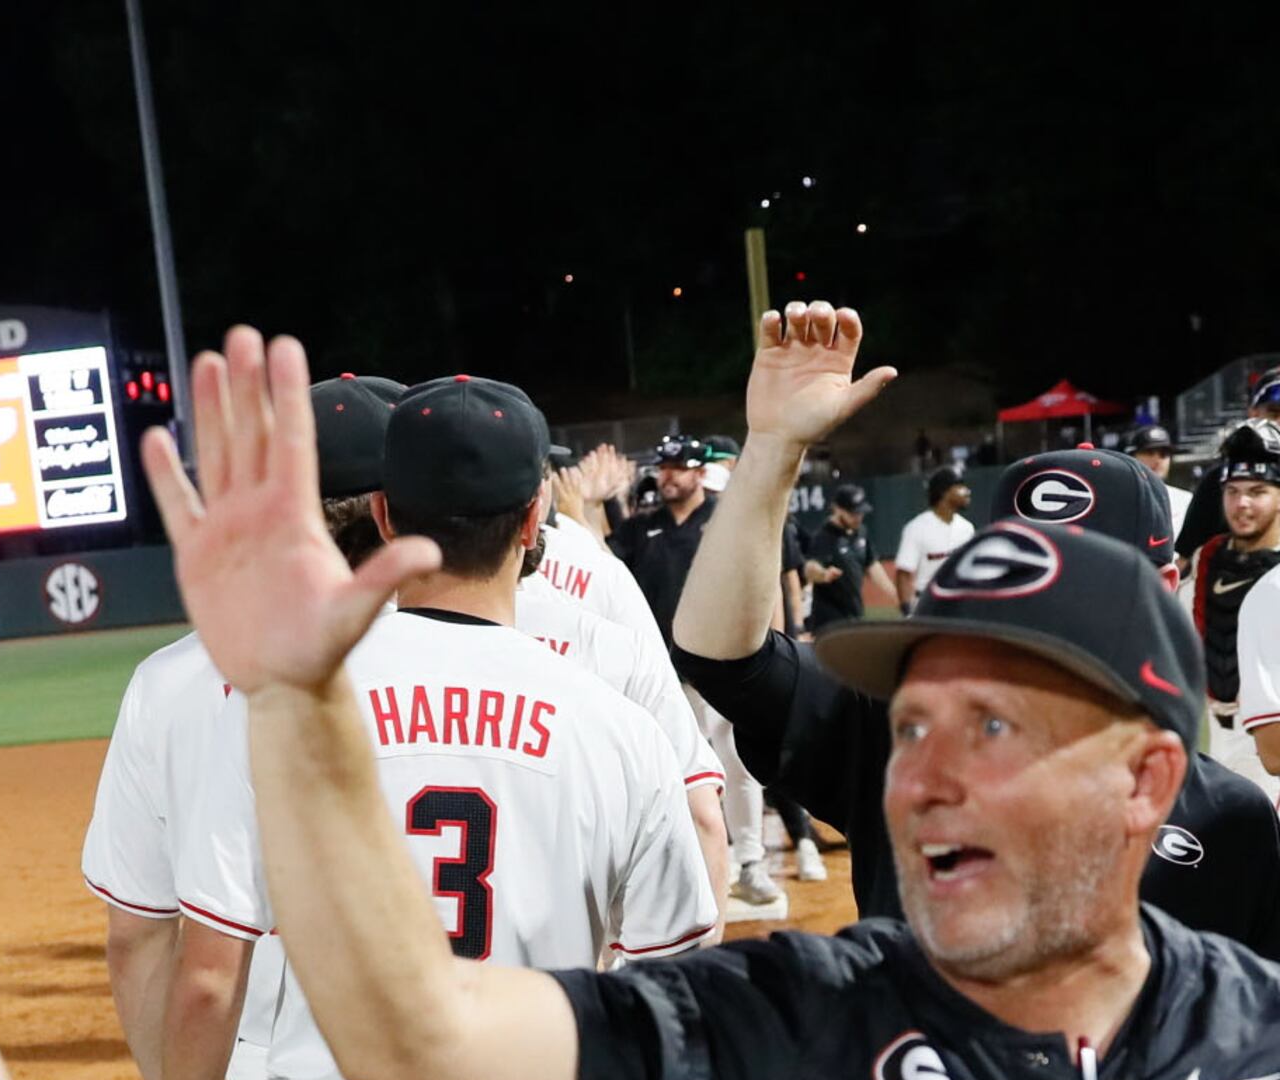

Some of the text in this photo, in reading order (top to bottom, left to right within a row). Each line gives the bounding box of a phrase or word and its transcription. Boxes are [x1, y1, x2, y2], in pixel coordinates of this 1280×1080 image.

[46, 563, 100, 623] SEC
[369, 684, 556, 760] HARRIS
[405, 785, 499, 961] 3
